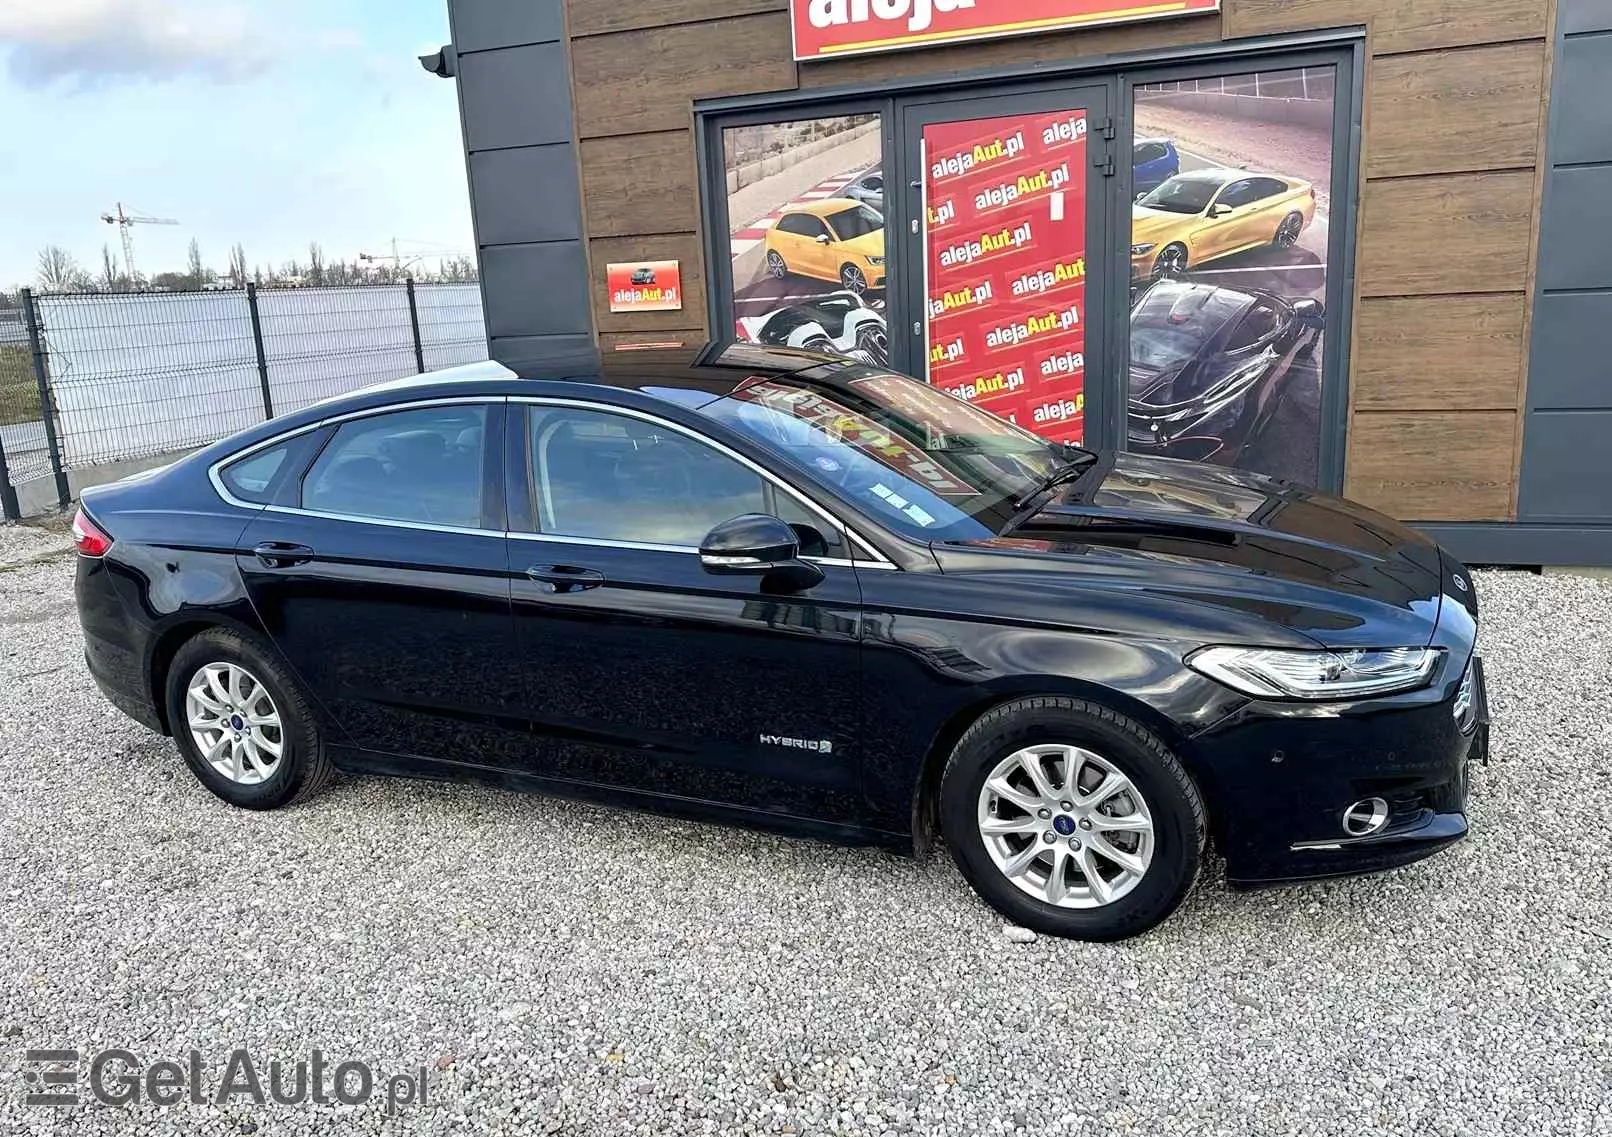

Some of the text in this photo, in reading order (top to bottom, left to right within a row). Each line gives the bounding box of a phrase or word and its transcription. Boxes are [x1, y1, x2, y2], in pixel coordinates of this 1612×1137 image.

[931, 131, 1025, 179] alejaAut.pl
[975, 163, 1070, 210] alejaAut.pl
[940, 222, 1032, 266] alejaAut.pl
[614, 287, 677, 303] alejaAut.pl
[985, 306, 1079, 347] alejaAut.pl
[945, 367, 1025, 401] ejaAut.pl
[760, 734, 819, 750] HYBRID
